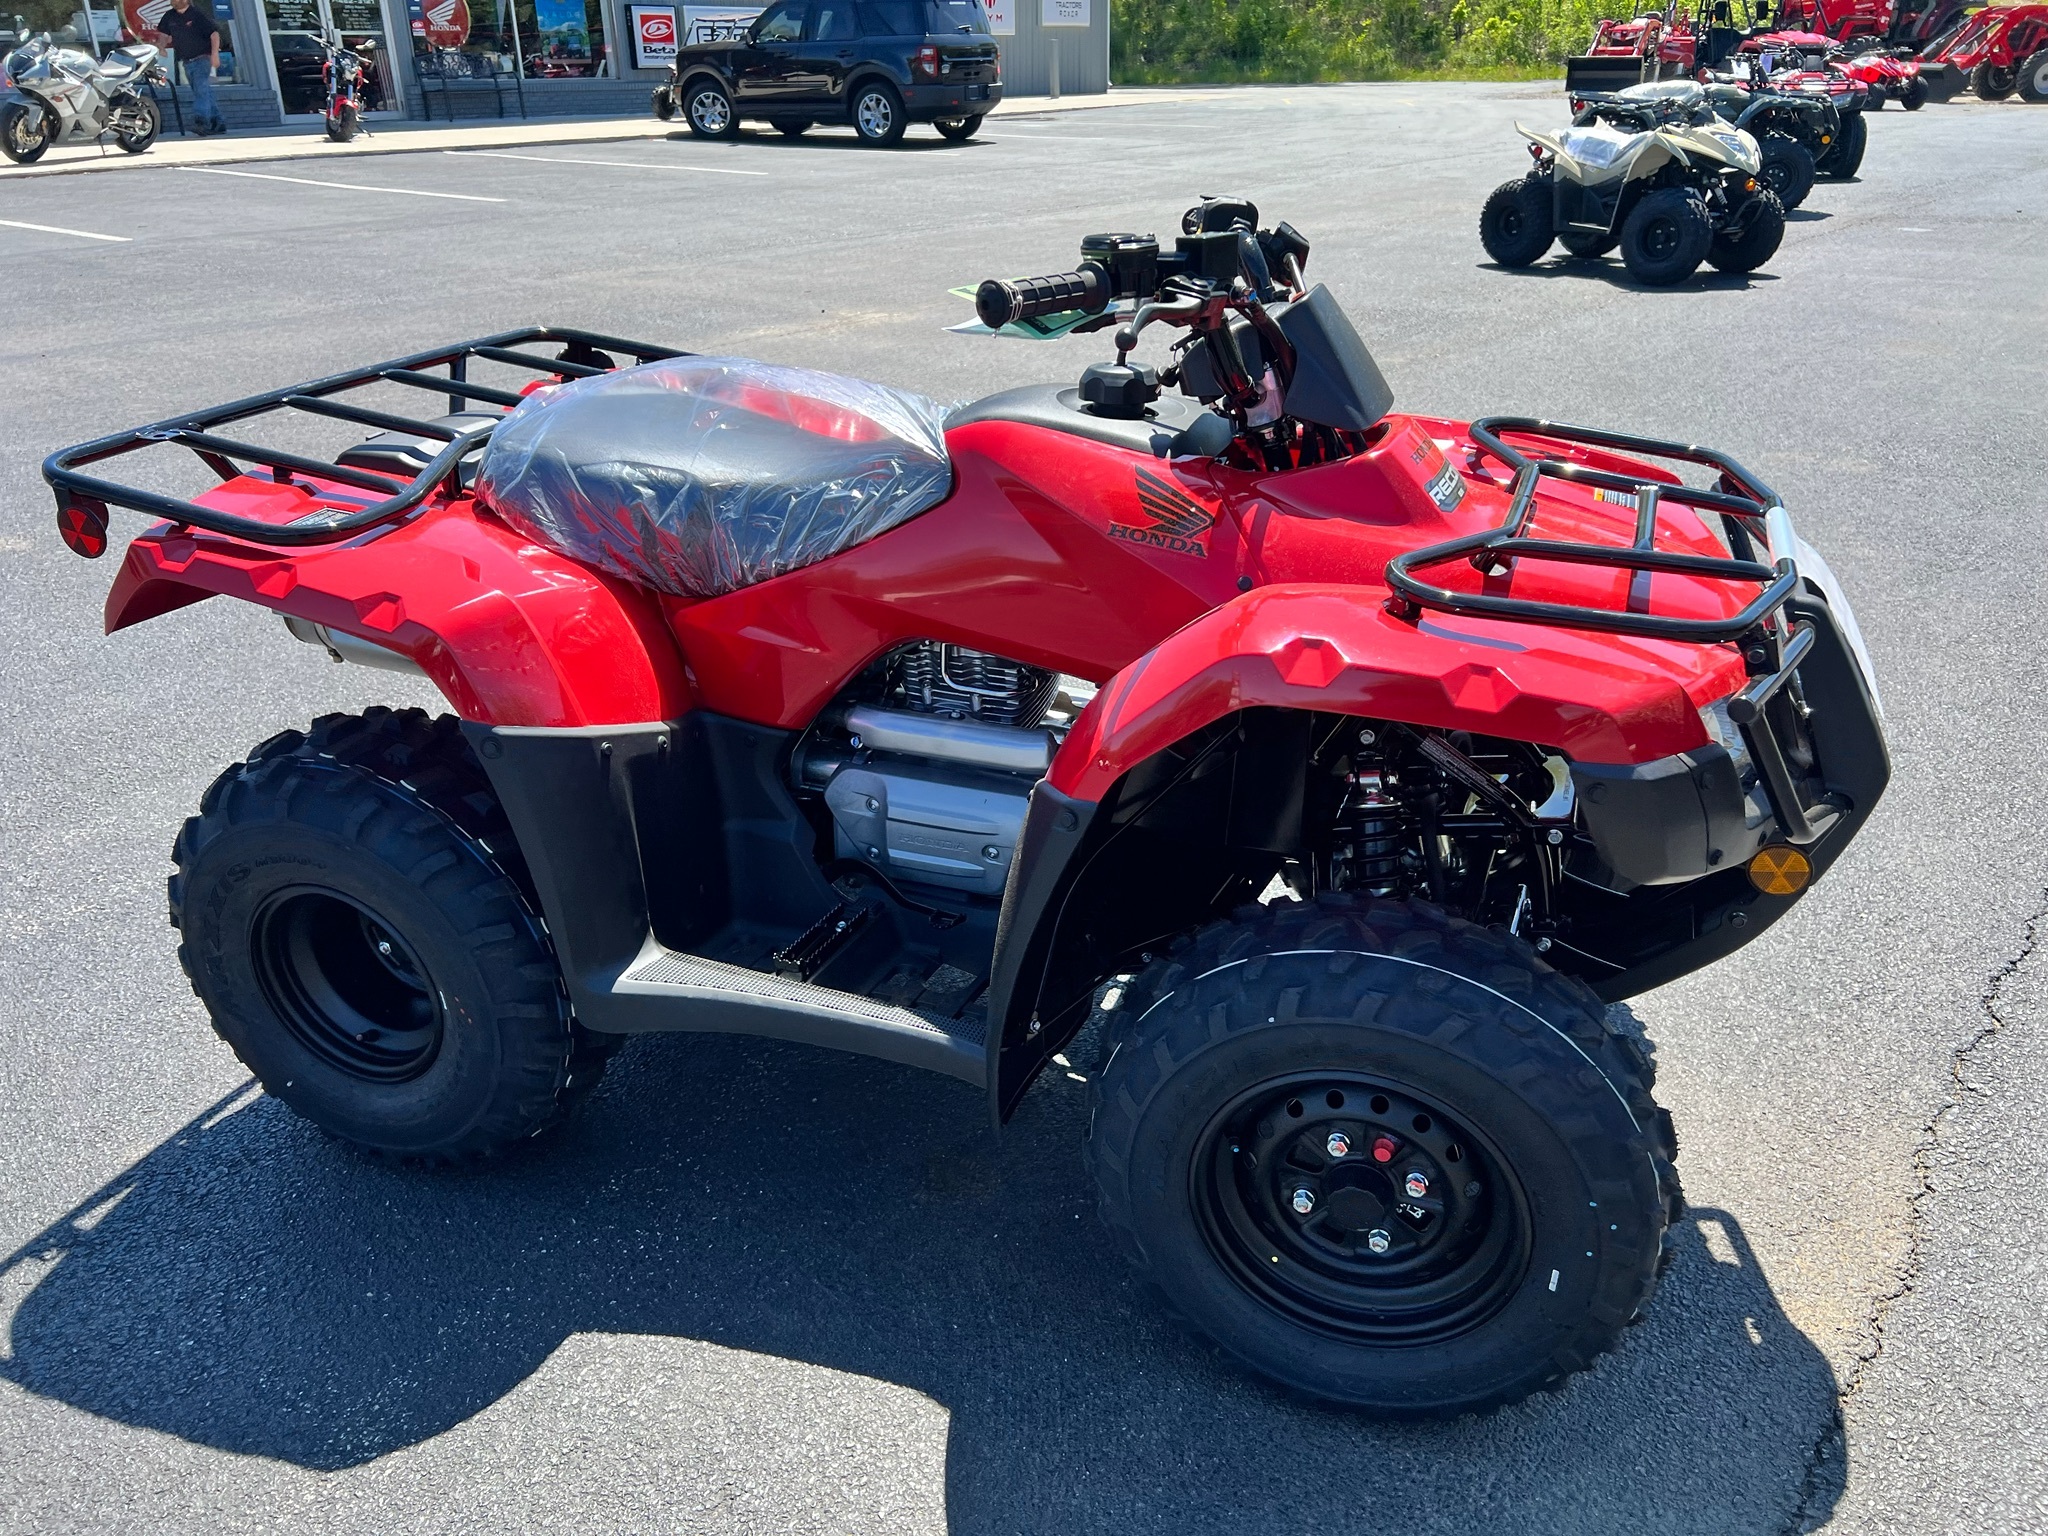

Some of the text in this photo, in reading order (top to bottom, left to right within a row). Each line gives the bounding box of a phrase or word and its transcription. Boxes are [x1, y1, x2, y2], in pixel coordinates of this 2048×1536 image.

[1055, 1, 1082, 9] TRACTORS
[987, 14, 1003, 22] YM
[643, 45, 676, 54] Beta
[1428, 464, 1460, 506] RECO
[1107, 523, 1207, 558] HONDA
[897, 832, 970, 853] HONDA
